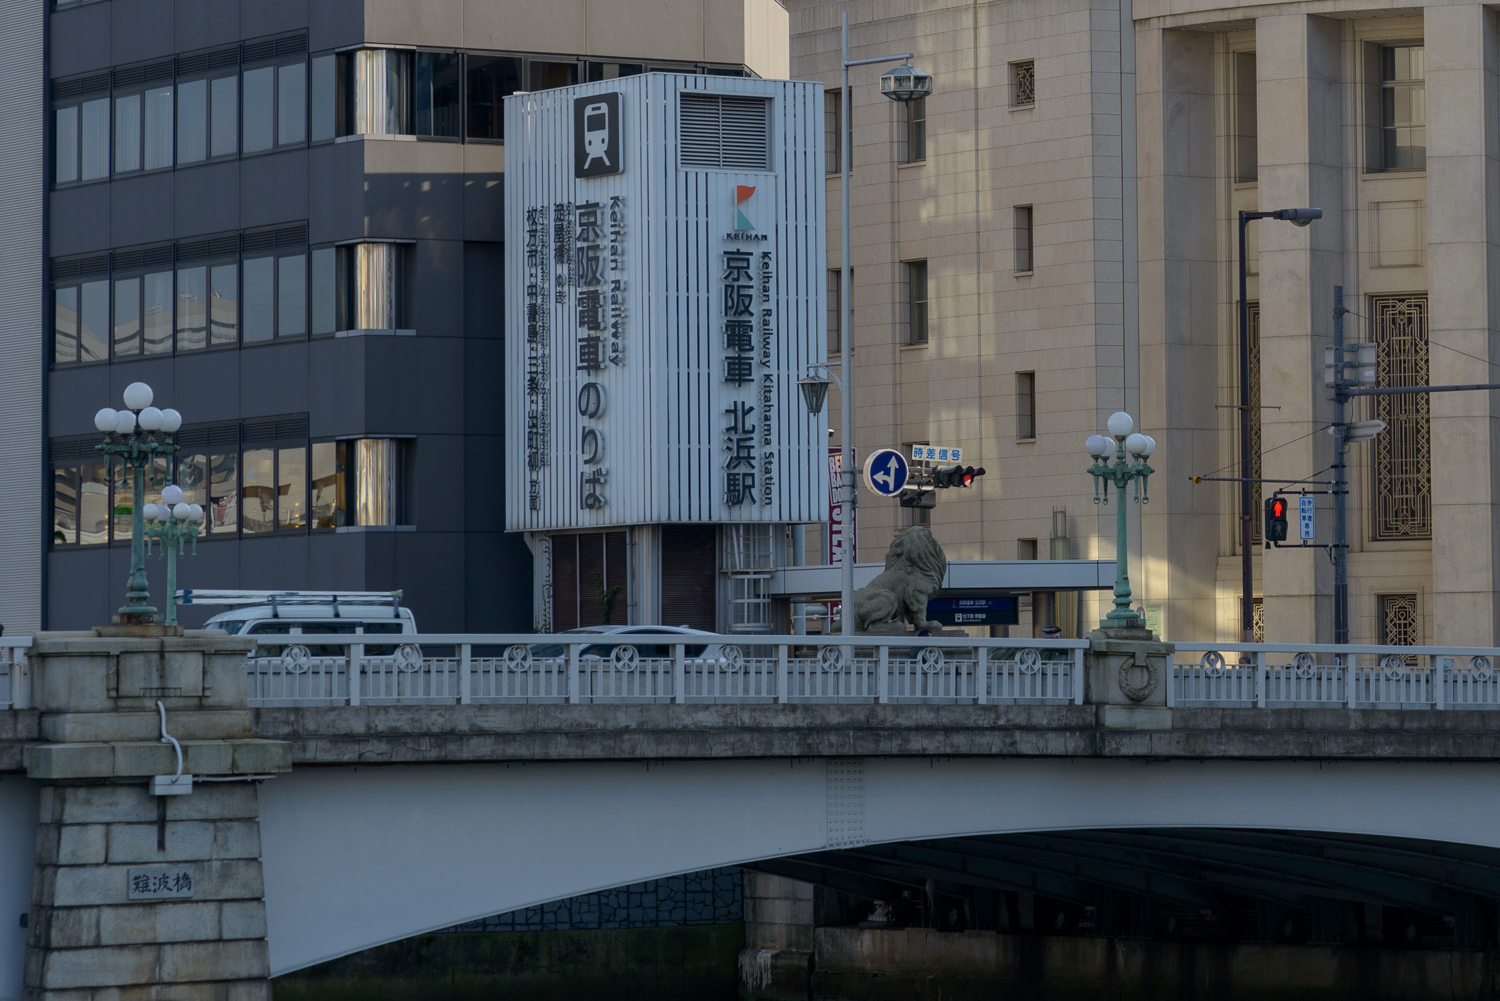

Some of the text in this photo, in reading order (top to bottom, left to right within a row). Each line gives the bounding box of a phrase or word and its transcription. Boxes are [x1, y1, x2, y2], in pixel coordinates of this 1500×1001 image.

[608, 195, 622, 366] Keihan Railway
[726, 232, 768, 241] KEIHAN
[575, 199, 605, 511] 京阪電車のりば
[723, 248, 757, 506] 京阪電車 北浜駅
[760, 251, 775, 506] Keihan Railway Kitahama Station
[913, 447, 961, 461] 時差信号
